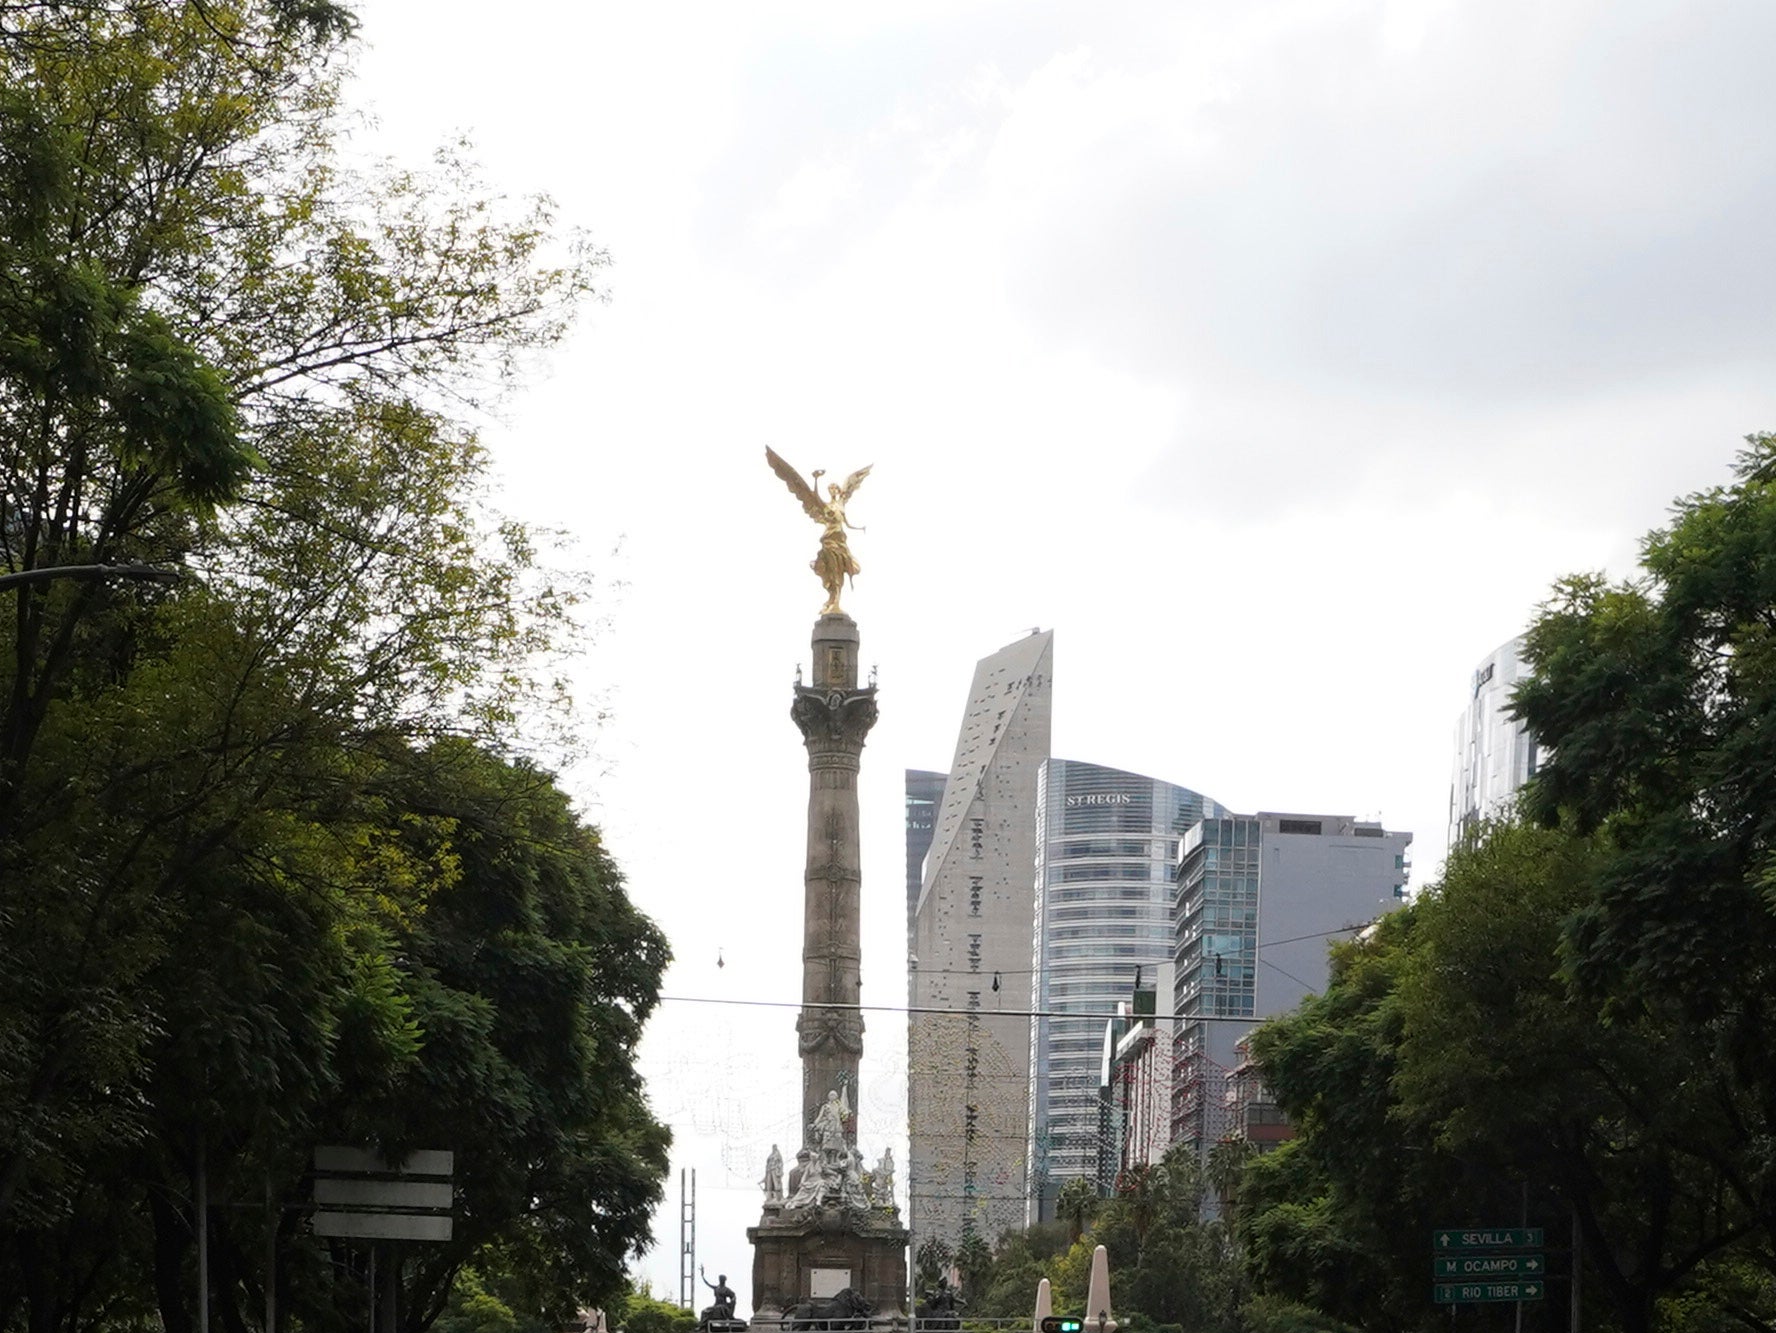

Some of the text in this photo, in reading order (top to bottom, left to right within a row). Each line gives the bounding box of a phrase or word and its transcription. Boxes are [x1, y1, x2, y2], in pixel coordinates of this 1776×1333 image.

[1462, 1233, 1513, 1245] SEVILLA
[1464, 1260, 1518, 1272] OCAMPO
[1462, 1287, 1481, 1298] RIO
[1487, 1285, 1518, 1297] TIBER
